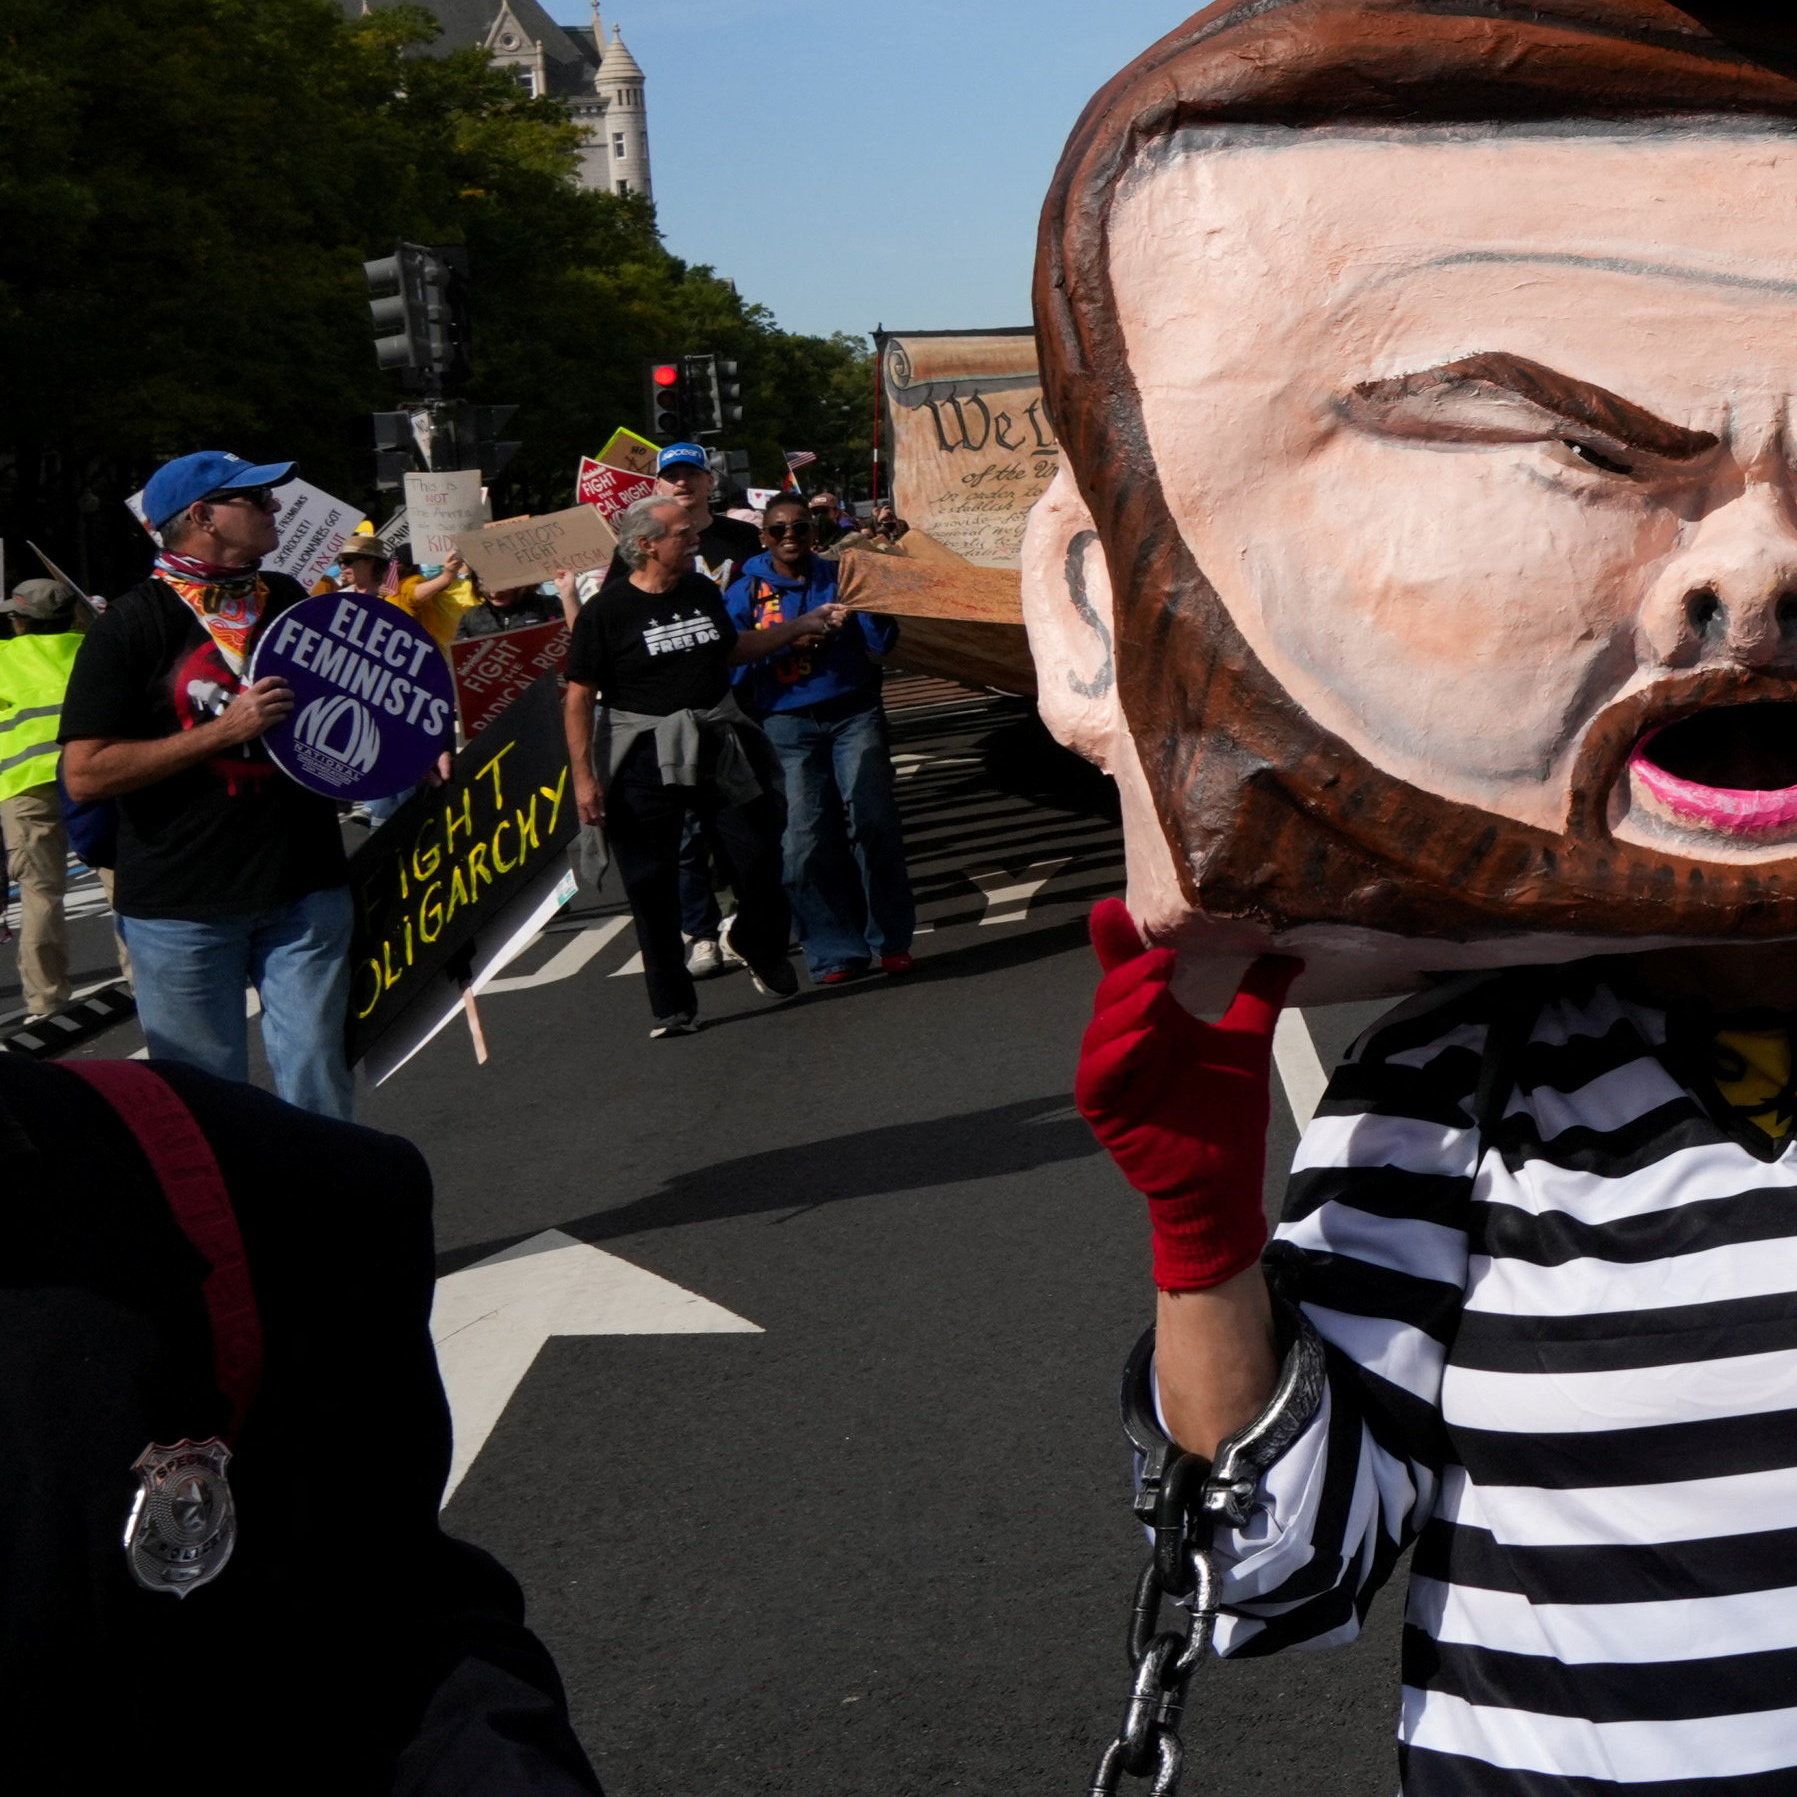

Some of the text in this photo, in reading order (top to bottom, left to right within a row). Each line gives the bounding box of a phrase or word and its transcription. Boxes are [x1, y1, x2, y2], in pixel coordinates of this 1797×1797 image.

[912, 383, 1026, 454] We
[405, 478, 438, 492] This
[581, 470, 618, 497] FIGHT
[961, 464, 997, 488] of
[988, 461, 1026, 482] the
[425, 493, 449, 503] NOT
[597, 490, 615, 500] THE
[324, 508, 342, 528] GOT
[483, 521, 566, 556] PATRIOTS
[308, 551, 333, 575] TAX
[326, 532, 347, 554] CUT
[514, 542, 558, 564] FIGHT
[542, 547, 609, 576] FASCISM
[328, 598, 434, 677] ELECT
[647, 628, 721, 656] FREE DC
[273, 617, 450, 737] FEMINISTS
[462, 639, 522, 694] FIGHT
[501, 662, 524, 683] THE
[293, 695, 381, 774] NOW
[293, 743, 360, 782] NATIONAL
